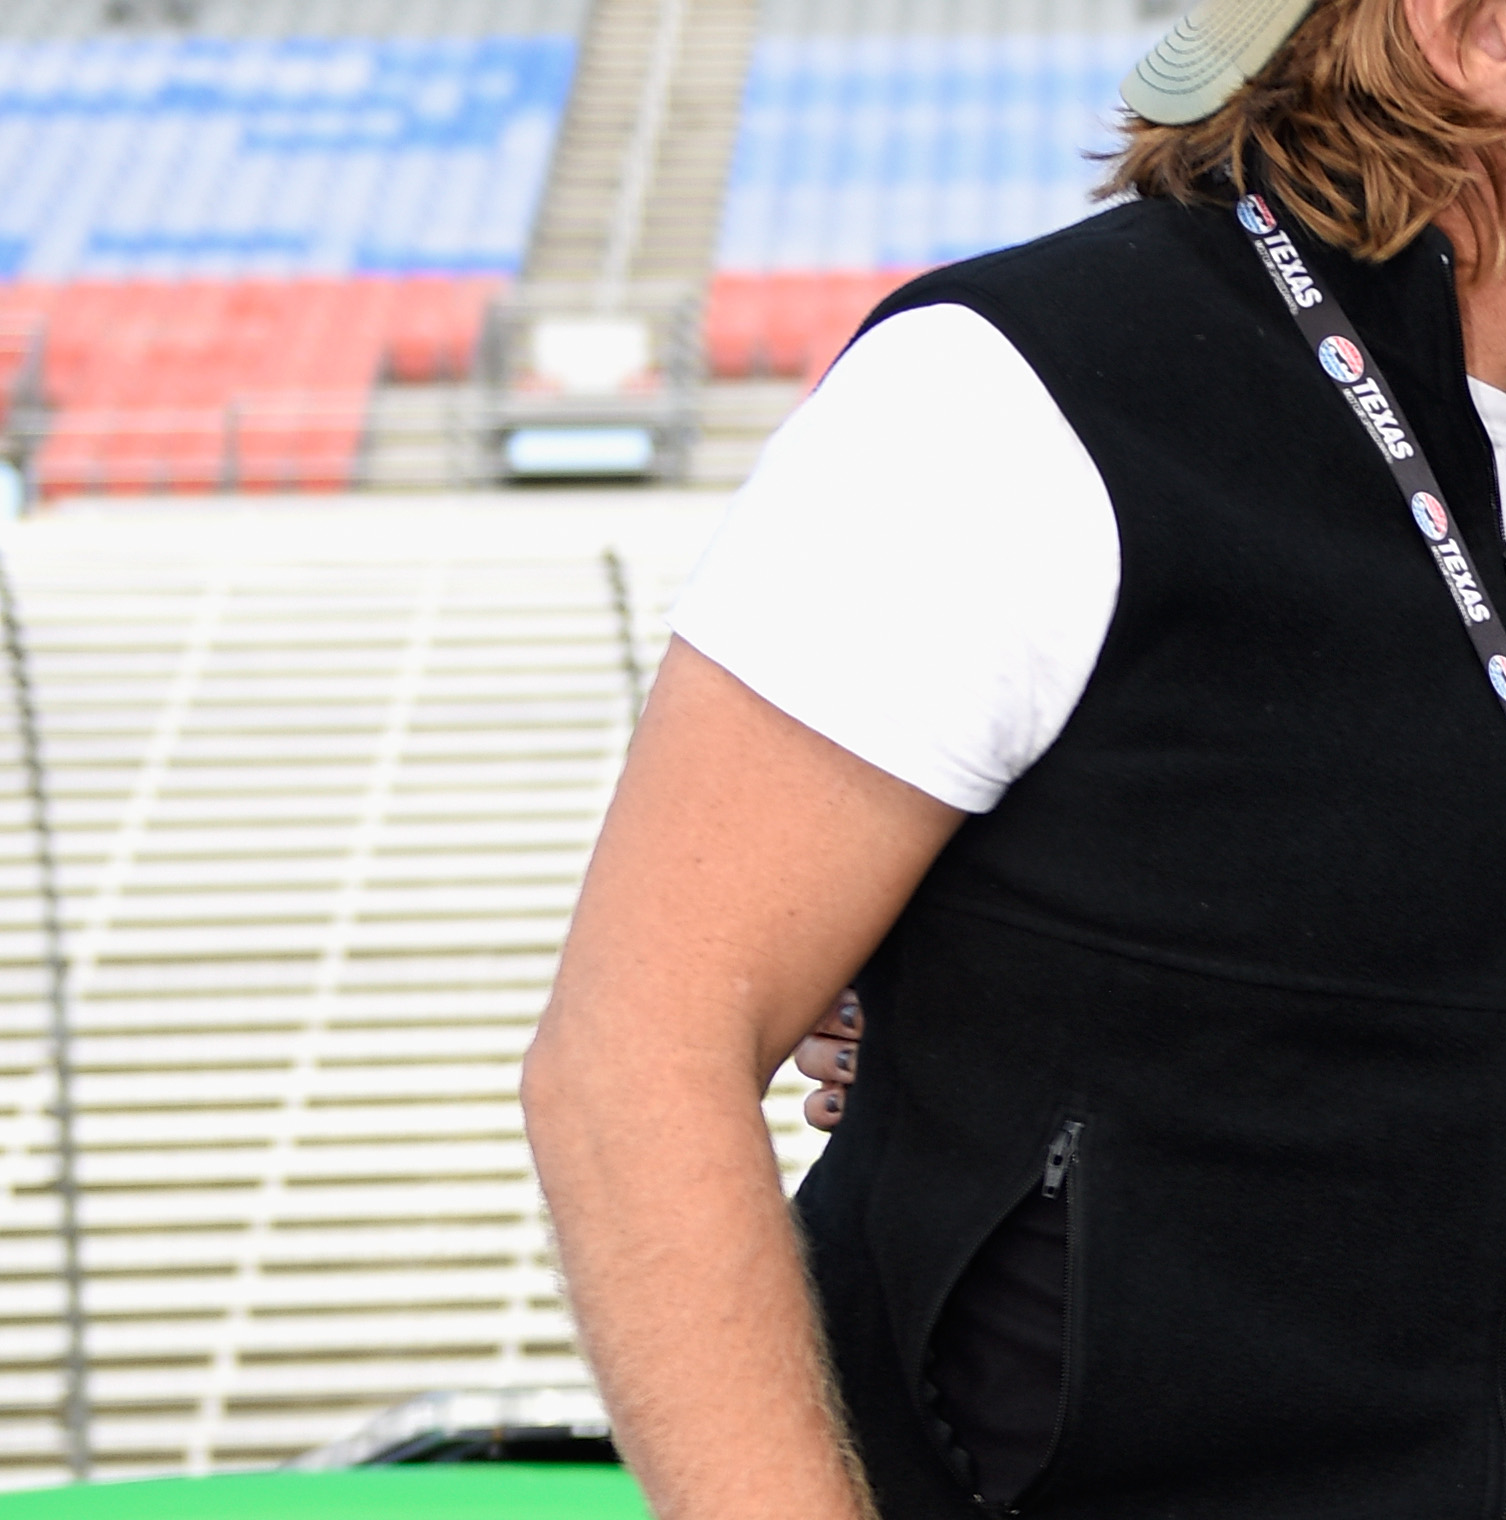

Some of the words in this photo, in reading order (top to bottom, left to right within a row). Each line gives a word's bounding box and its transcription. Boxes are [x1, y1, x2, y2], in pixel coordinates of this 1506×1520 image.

[1263, 230, 1323, 308] TEXAS
[1352, 377, 1414, 459] TEXAS
[1437, 538, 1490, 622] TEXAS
